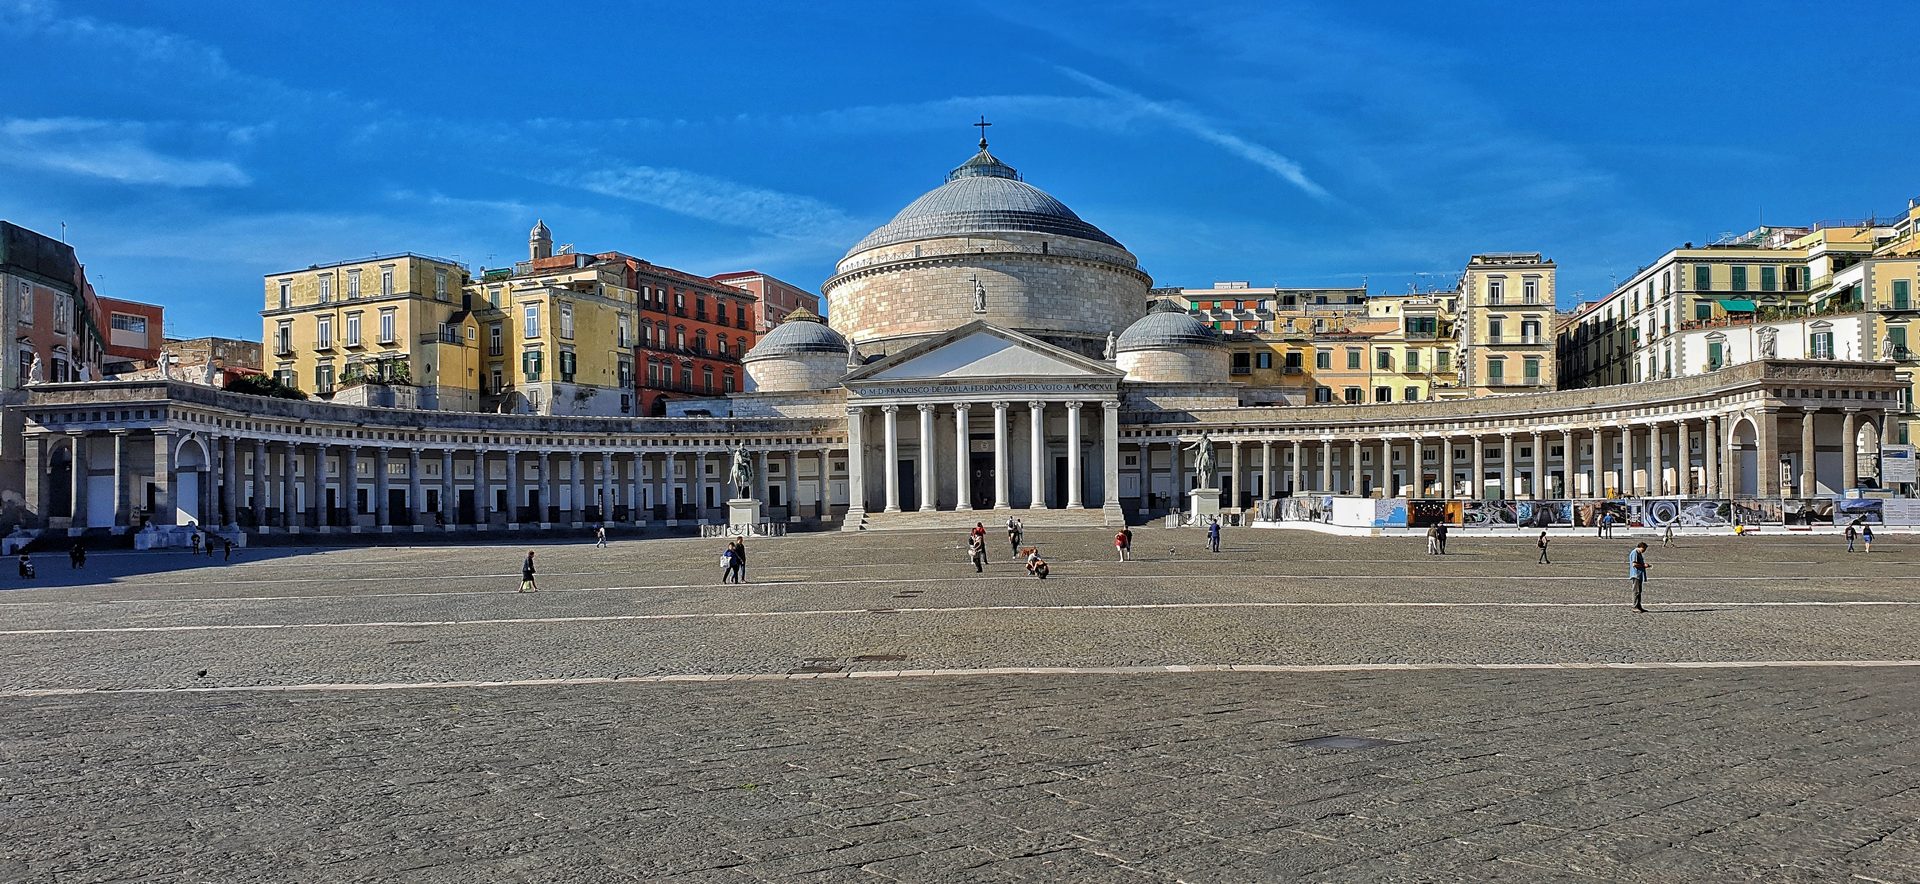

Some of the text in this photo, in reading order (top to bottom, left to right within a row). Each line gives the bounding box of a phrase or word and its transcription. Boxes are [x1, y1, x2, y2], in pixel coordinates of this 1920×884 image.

[887, 387, 930, 395] FRANCISCO
[944, 385, 968, 393] PAVLA
[971, 384, 1022, 392] FERDINANDVS
